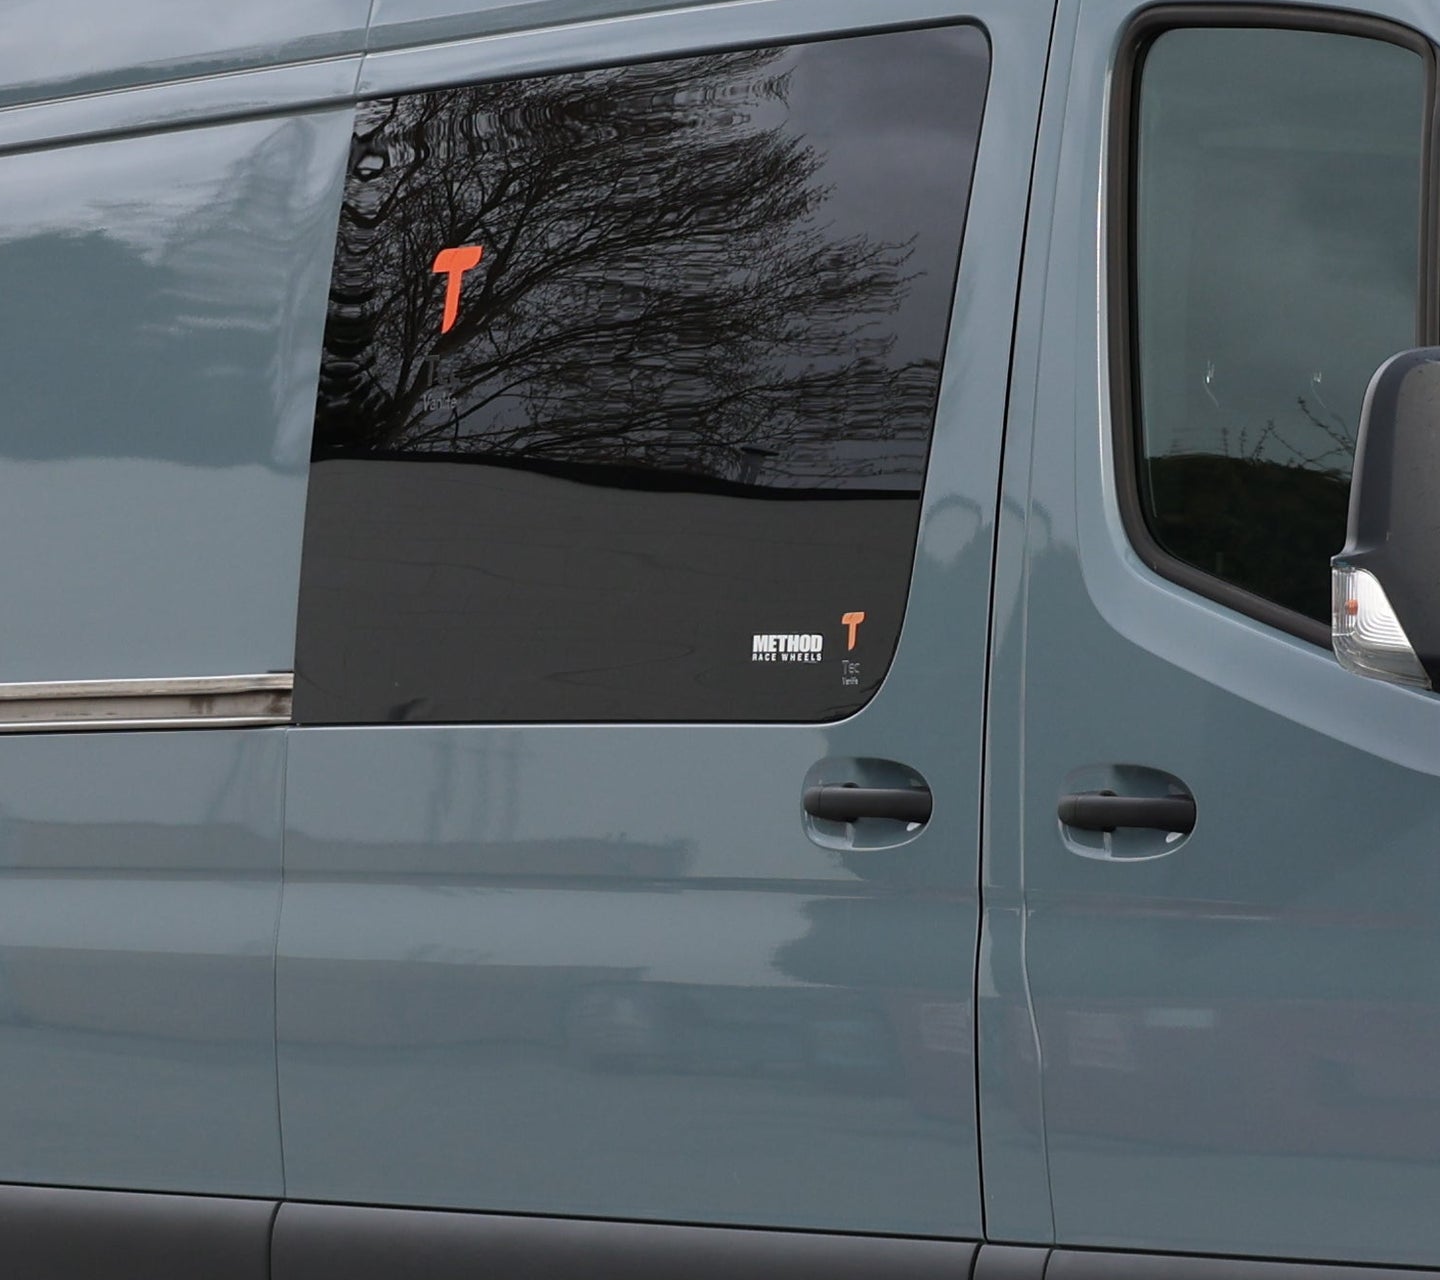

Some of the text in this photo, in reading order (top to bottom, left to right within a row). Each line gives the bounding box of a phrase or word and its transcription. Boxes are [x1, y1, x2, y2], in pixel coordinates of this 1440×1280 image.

[432, 245, 484, 335] T
[841, 611, 866, 651] T
[752, 634, 824, 652] METHOD
[752, 653, 823, 661] RACE WHEELS
[841, 659, 860, 674] Tec
